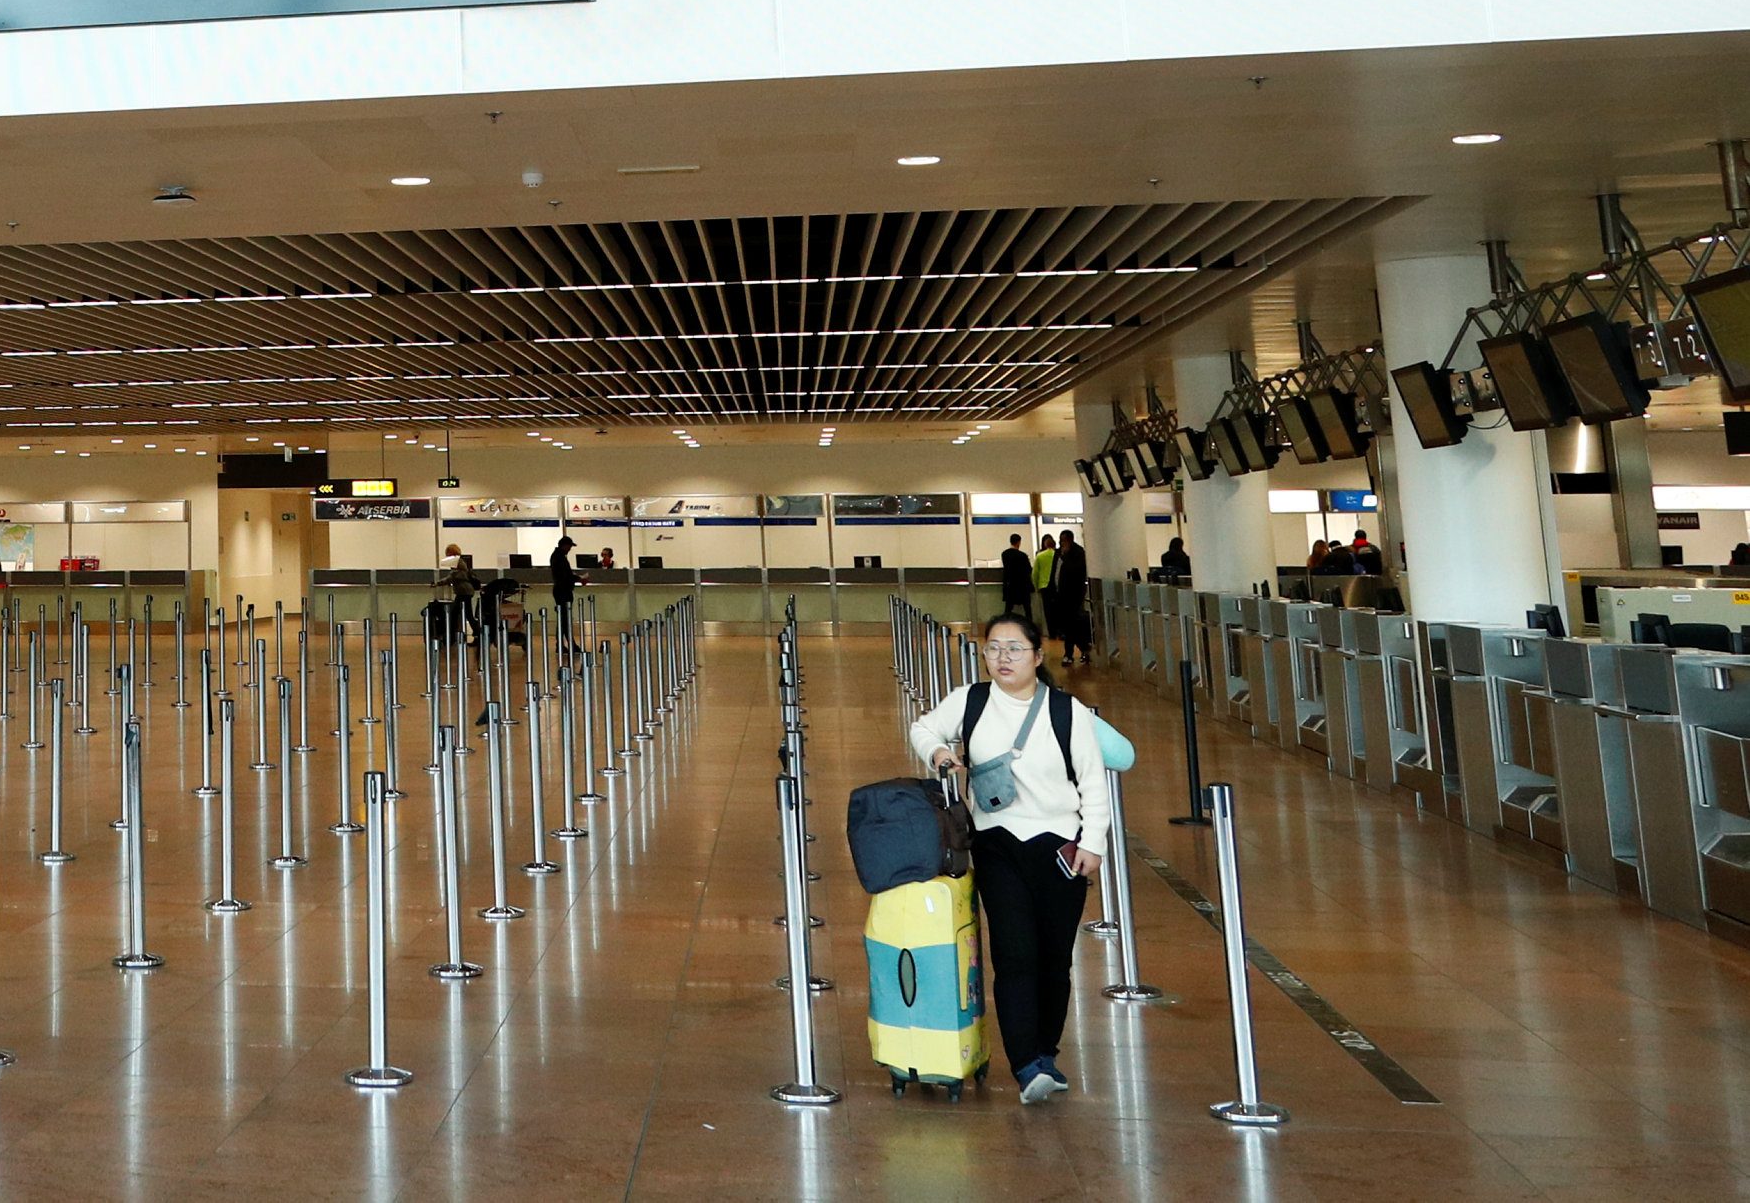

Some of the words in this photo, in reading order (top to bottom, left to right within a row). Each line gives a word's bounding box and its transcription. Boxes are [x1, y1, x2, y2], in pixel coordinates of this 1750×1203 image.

[479, 504, 520, 513] DELTA
[583, 503, 621, 512] DELTA
[1657, 516, 1699, 525] YANAIR
